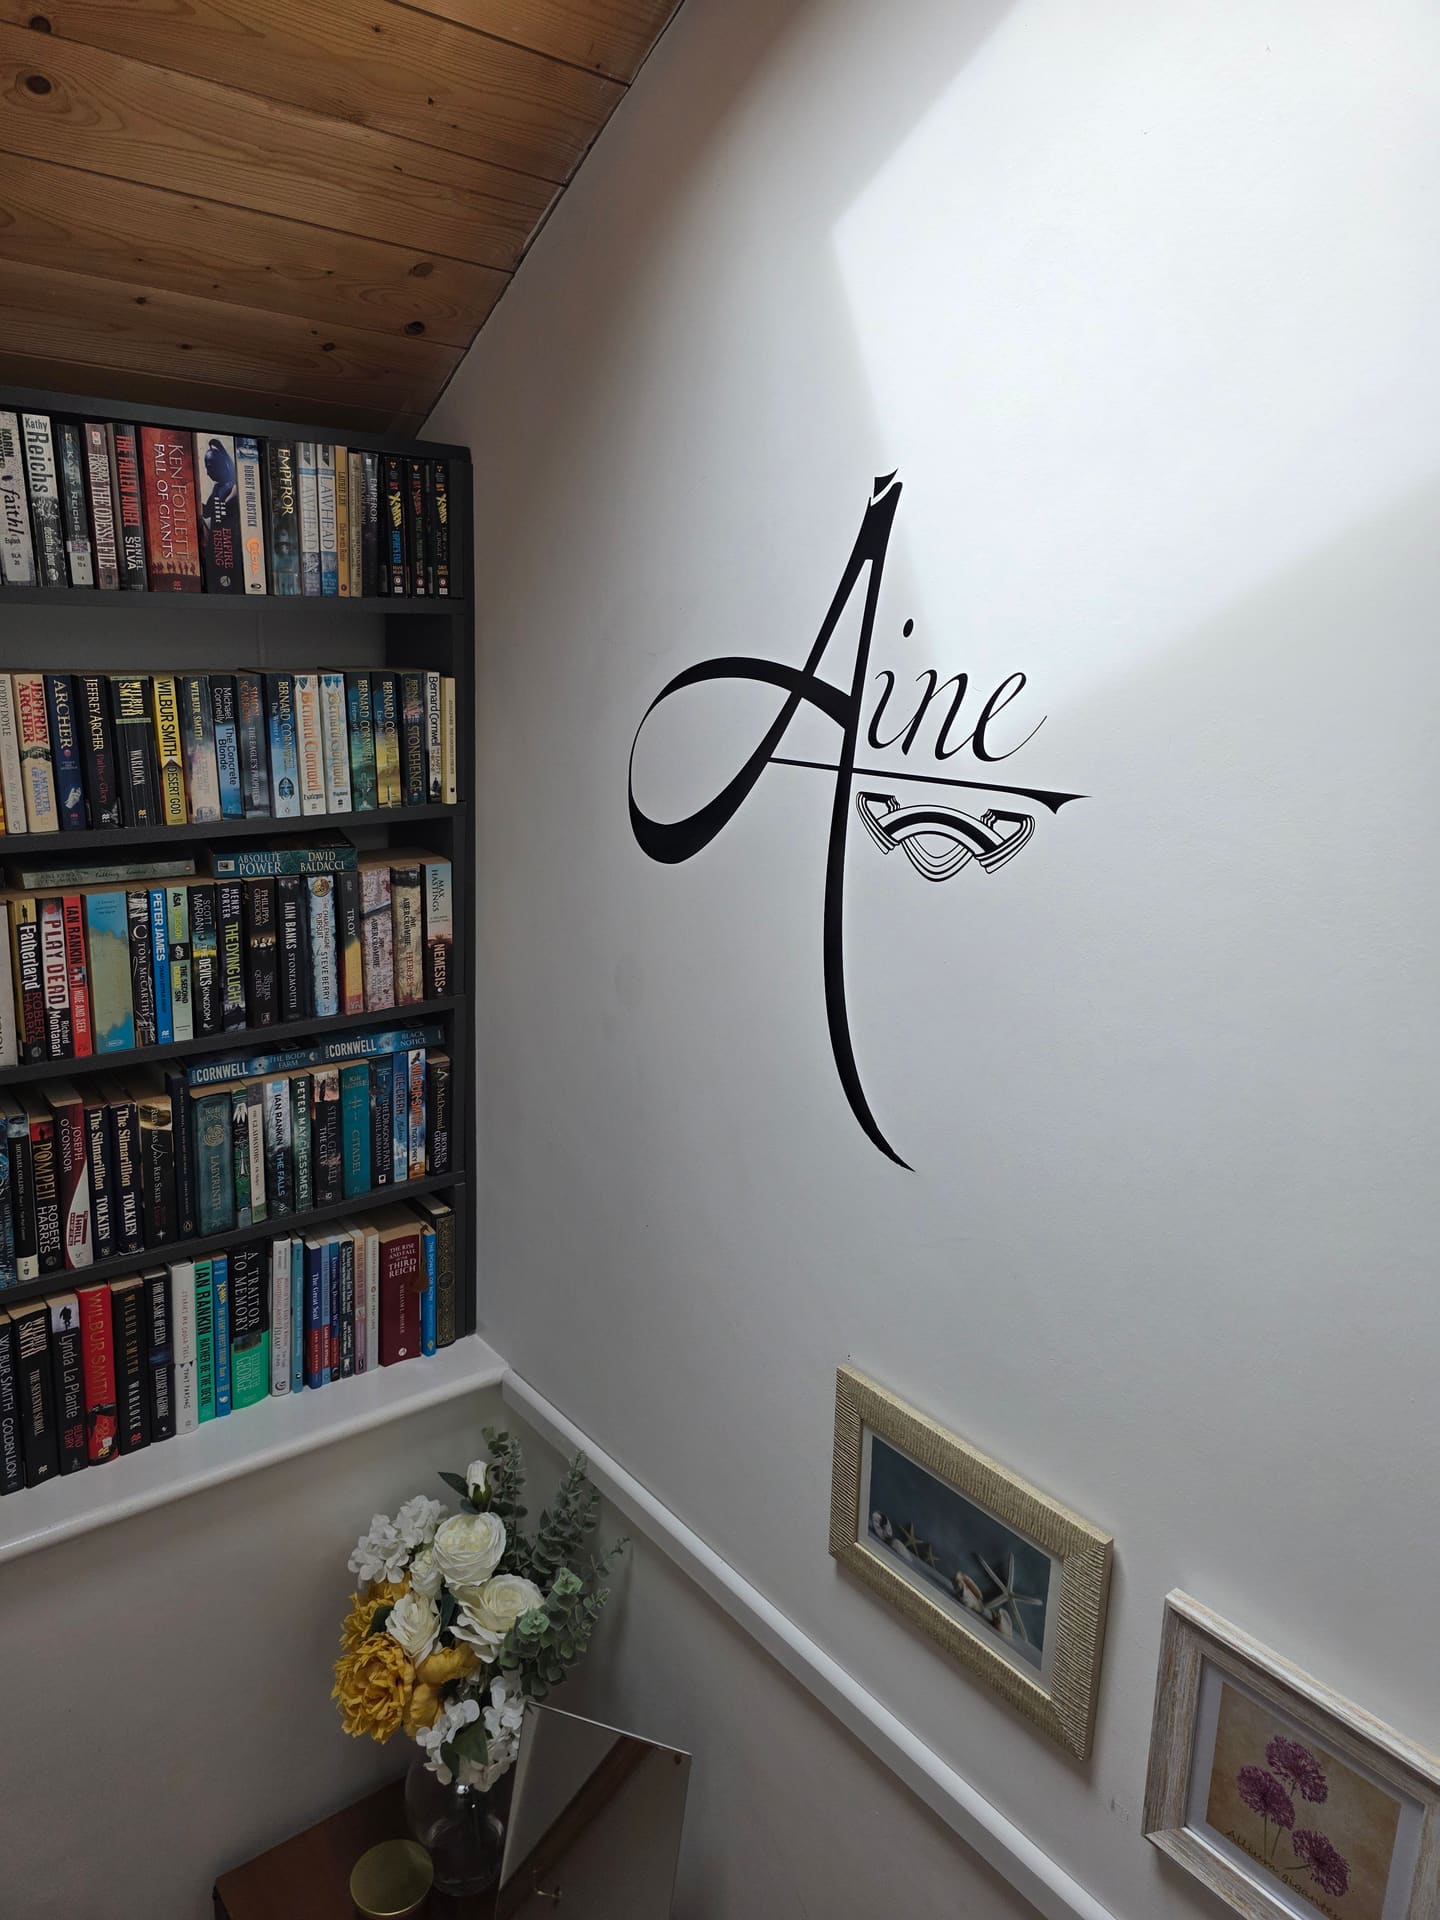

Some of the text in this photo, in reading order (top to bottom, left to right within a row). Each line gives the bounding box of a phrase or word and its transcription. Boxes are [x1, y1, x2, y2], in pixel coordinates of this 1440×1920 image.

[2, 429, 14, 457] KARIN
[25, 417, 48, 432] Kathy
[27, 431, 53, 493] Reichs
[117, 435, 140, 527] THE FALLEN ANGEL
[244, 465, 256, 491] ROBERT
[277, 448, 294, 516] EMPEROR
[65, 451, 81, 531] KATHY REICHS
[154, 443, 173, 559] FALL OF GIANTS
[168, 444, 189, 559] KEN FOLLETT
[302, 475, 317, 550] LAWHEAD
[369, 478, 378, 523] EMPEROR
[92, 486, 116, 569] THE ODESSA FILE
[320, 475, 335, 551] LAWHEAD
[125, 536, 136, 570] SILVA
[134, 536, 144, 570] DANIEL
[213, 530, 224, 566] RISING
[222, 528, 233, 568] EMPIRE
[18, 682, 34, 743] ARCHER
[30, 680, 48, 744] JEFFREY
[53, 680, 73, 749] ARCHER
[84, 678, 104, 751] JEFFREY ARCHER
[119, 682, 132, 716] SMITH
[130, 682, 144, 715] WILBUR
[157, 681, 177, 757] WILBUR SMITH
[190, 681, 203, 741] WILBUR SMITH
[214, 688, 225, 724] Connelly
[223, 687, 233, 720] Michael
[250, 686, 260, 716] SIMON
[278, 681, 290, 721] BERNARD
[300, 690, 315, 738] Bernard
[358, 679, 370, 718] BERNARD
[382, 682, 394, 719] BERNARD
[429, 676, 440, 746] Bernard Cornwell
[1, 710, 12, 737] DOYLE
[130, 750, 145, 786] WARLOCK
[217, 739, 227, 770] Blonde
[225, 727, 237, 785] The Concrete
[303, 740, 321, 792] Cornwell
[407, 725, 421, 793] STONEHENGE
[33, 778, 44, 817] HONOUR
[168, 768, 181, 815] DESERT GOD
[238, 852, 281, 863] ABSOLUTE
[239, 862, 282, 875] POWER
[300, 860, 345, 872] BALDACCI
[308, 851, 336, 862] DAVID
[203, 899, 212, 925] SCOTT
[222, 888, 231, 918] PORTER
[230, 888, 240, 915] HENRY
[254, 888, 263, 926] GREGORY
[261, 889, 269, 924] PHILIPPA
[431, 869, 440, 912] HASTINGS
[153, 893, 165, 961] PETER JAMES
[193, 894, 204, 934] MARIANI
[347, 908, 355, 936] TROY
[20, 925, 40, 990] Fatherland
[66, 906, 83, 966] IAN RANKIN
[138, 943, 147, 964] TOM
[284, 902, 297, 1008] IAIN BANKS STONEMOUTH
[44, 920, 66, 1008] PLAY DEAD
[225, 923, 243, 1004] THE DYING LIGHT
[321, 952, 330, 1000] STEVE BERRY
[434, 944, 446, 987] NEMESIS
[32, 992, 45, 1041] ROBERT
[74, 990, 87, 1033] HIDE AND SEEK
[174, 990, 182, 1002] SIN
[202, 987, 211, 1021] KINGDOM
[24, 993, 35, 1044] HARRIS
[49, 1010, 64, 1057] Montanari
[61, 1020, 70, 1044] Richard
[329, 1039, 376, 1057] CORNWELL
[197, 1061, 248, 1082] CORNWELL
[411, 1063, 423, 1097] WILBUR
[274, 1094, 283, 1146] IAN RANKIN
[297, 1081, 308, 1198] PETER MAY CHESSMEN
[327, 1105, 337, 1138] STELLA
[60, 1119, 72, 1172] O'CONNOR
[72, 1126, 83, 1161] JOSEPH
[276, 1152, 284, 1169] THE
[34, 1142, 56, 1201] POMPEII
[90, 1111, 111, 1241] The Silmarillion TOLKIEN
[117, 1108, 137, 1237] The Silmarillion TOLKIEN
[211, 1155, 221, 1210] LABYRINTH
[37, 1206, 51, 1254] HARRIS
[47, 1204, 61, 1250] ROBERT
[402, 1242, 415, 1250] RISE
[388, 1258, 417, 1271] THIRD
[389, 1265, 417, 1278] REICH
[195, 1266, 211, 1335] IAN RANKIN
[234, 1252, 248, 1331] TO MEMORY
[247, 1252, 260, 1327] A TRAITOR
[19, 1322, 35, 1359] SMITH
[33, 1317, 47, 1352] WILBUR
[87, 1293, 105, 1352] WILBUR
[125, 1294, 141, 1429] WILBUR SMITH WARLOCK
[200, 1338, 210, 1362] RATHER
[59, 1334, 80, 1418] Lynda La Plante
[91, 1355, 108, 1401] SMITH
[237, 1357, 250, 1393] GEORGE
[1, 1373, 17, 1478] SMITH GOLDEN LION
[64, 1429, 75, 1448] FURY
[73, 1424, 83, 1447] BLIND
